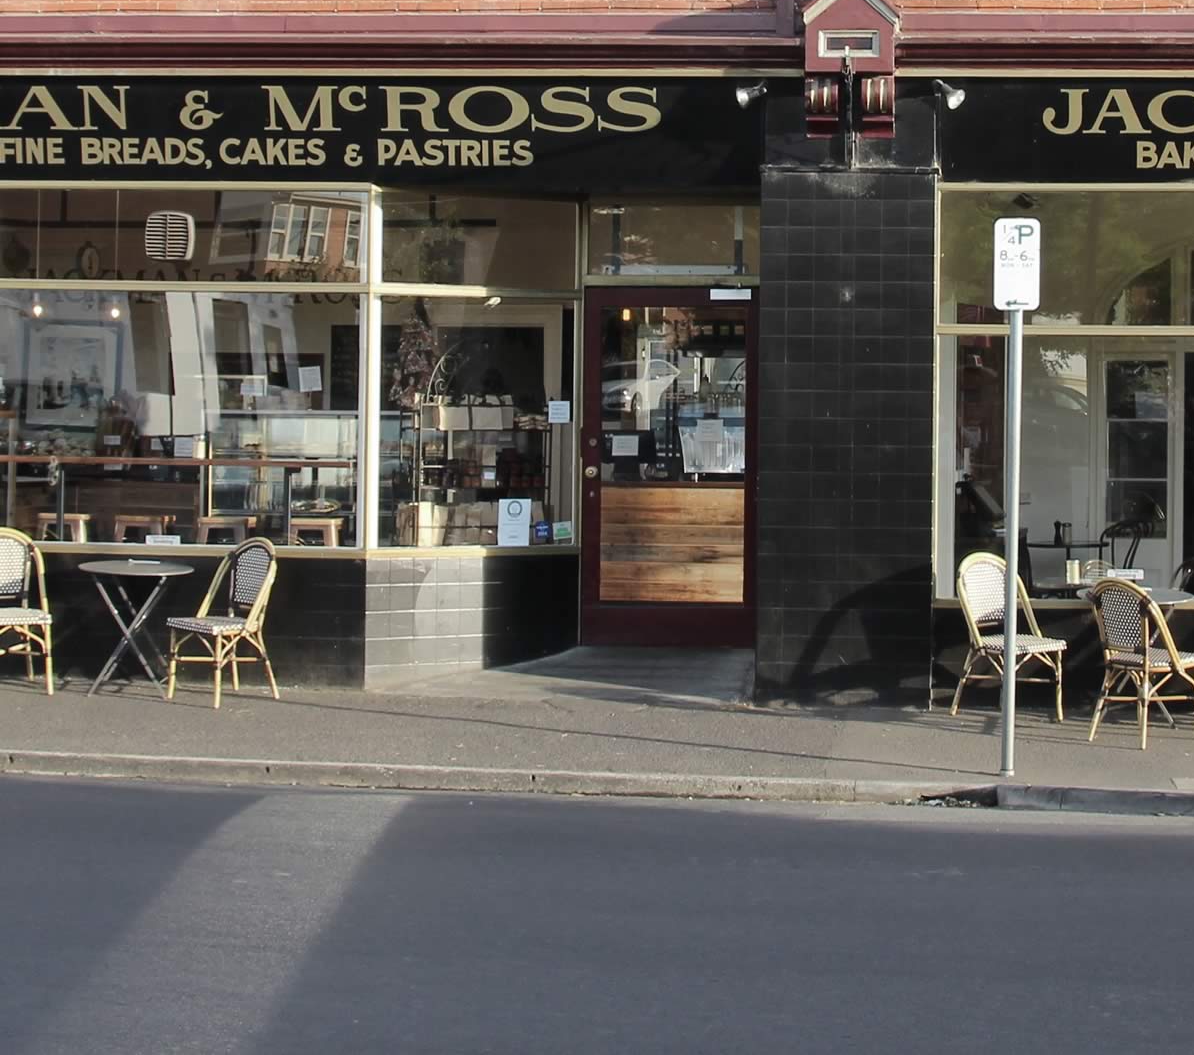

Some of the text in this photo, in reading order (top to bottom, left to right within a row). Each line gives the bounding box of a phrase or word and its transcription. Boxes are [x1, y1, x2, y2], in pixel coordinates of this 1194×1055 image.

[0, 85, 131, 131] AN
[179, 90, 224, 131] &
[0, 137, 534, 170] FINE BREADS, CAKES & PASTRIES
